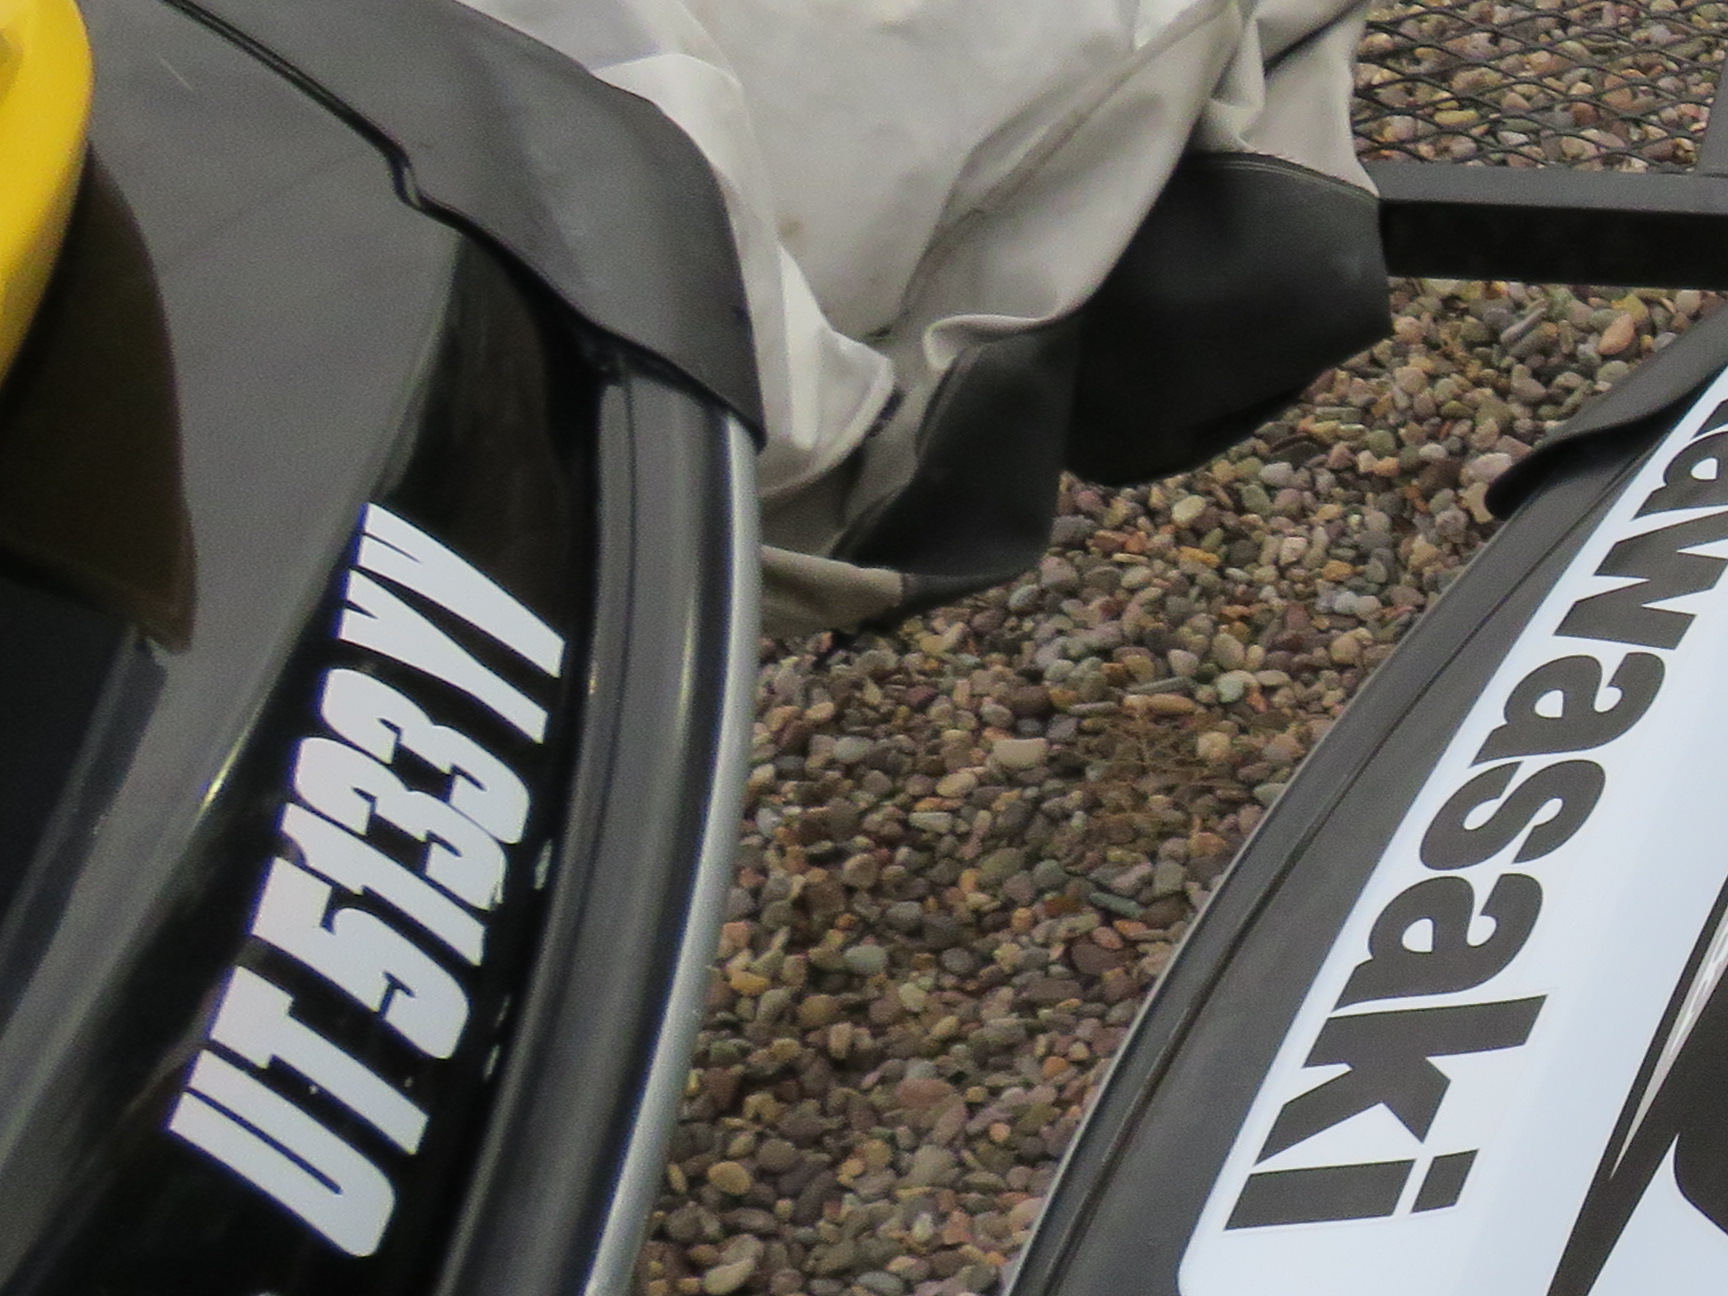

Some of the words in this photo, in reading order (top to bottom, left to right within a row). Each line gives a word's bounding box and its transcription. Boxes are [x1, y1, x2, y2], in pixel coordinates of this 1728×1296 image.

[337, 501, 566, 743] YY
[250, 666, 530, 1060] 5133
[168, 962, 429, 1258] UT
